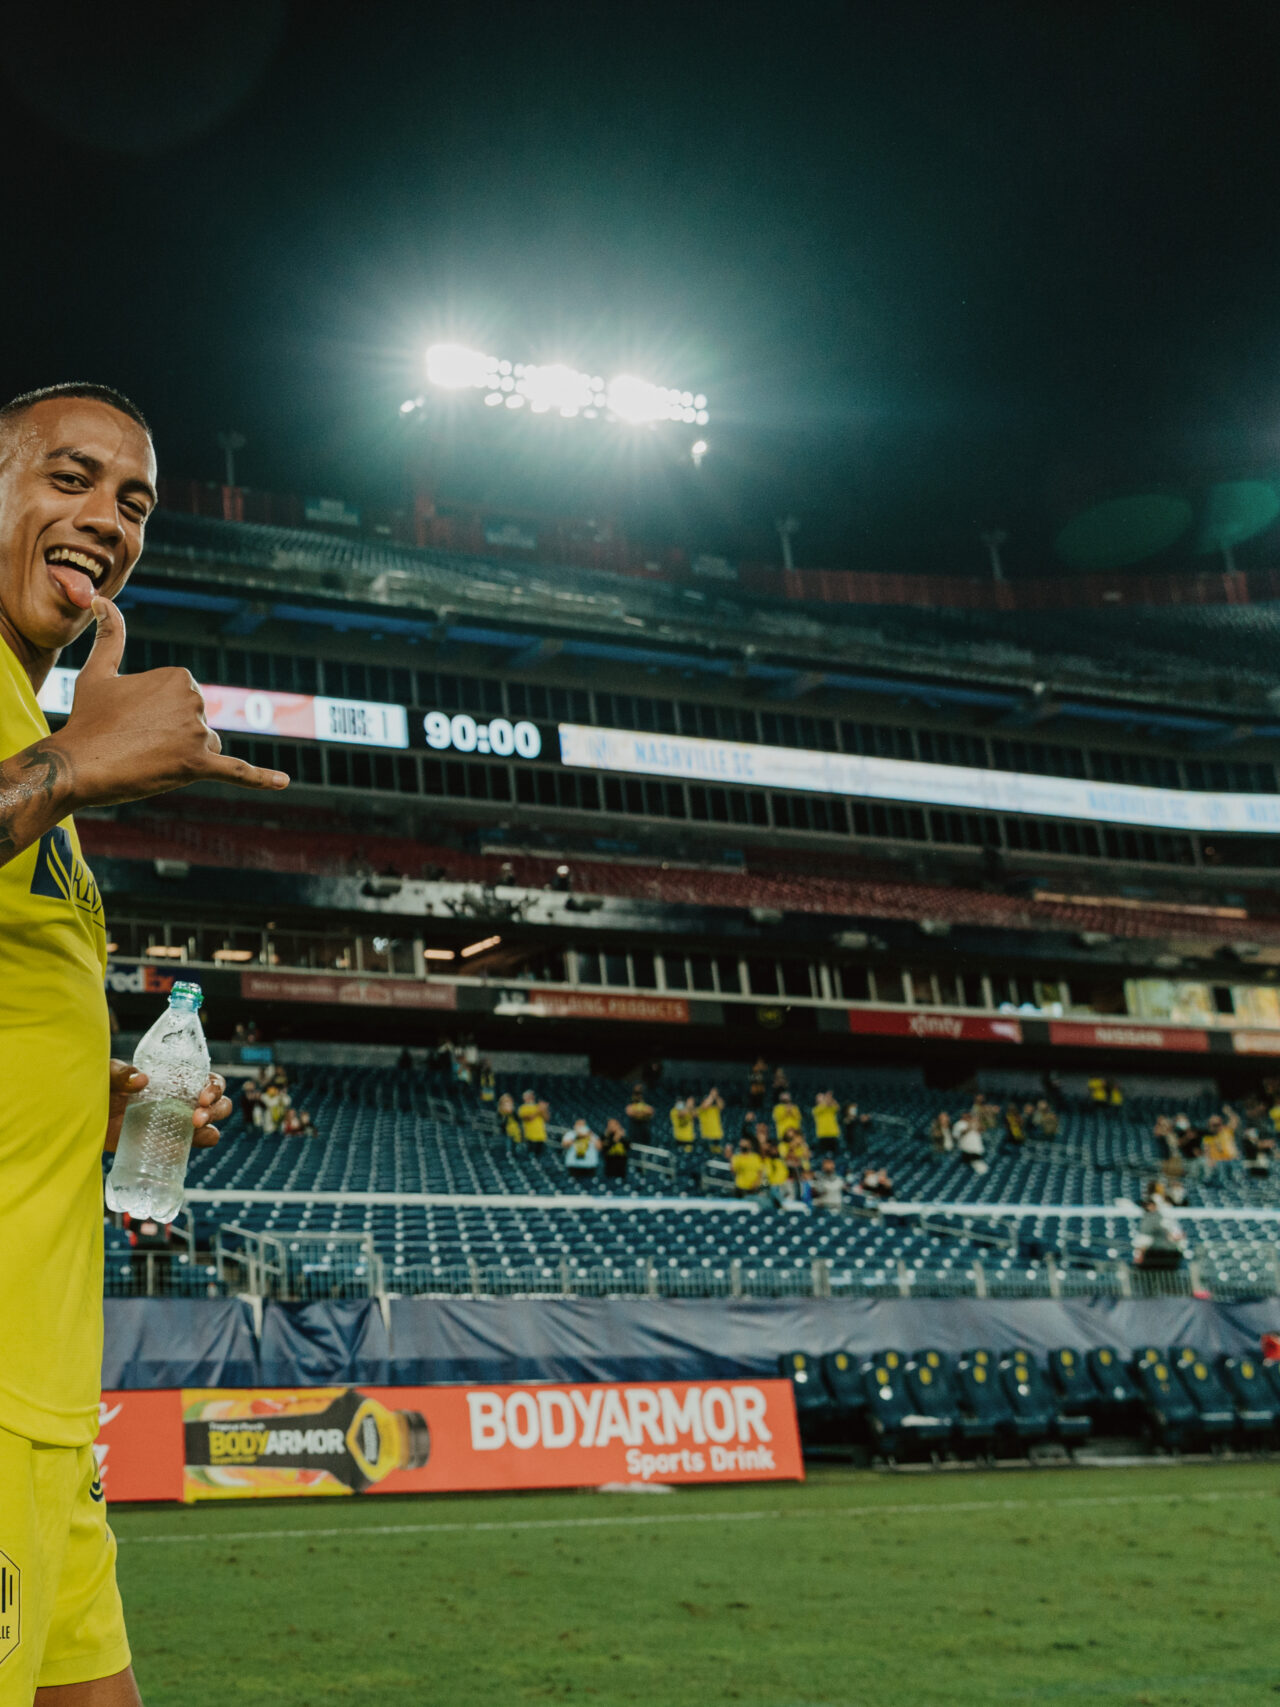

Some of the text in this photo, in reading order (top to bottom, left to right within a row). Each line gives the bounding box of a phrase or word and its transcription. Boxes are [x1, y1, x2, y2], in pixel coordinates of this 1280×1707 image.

[423, 711, 542, 758] 90:00
[467, 1387, 772, 1450] BODYARMOR
[208, 1428, 346, 1457] BODYARMOR
[626, 1445, 776, 1480] Sports Drink
